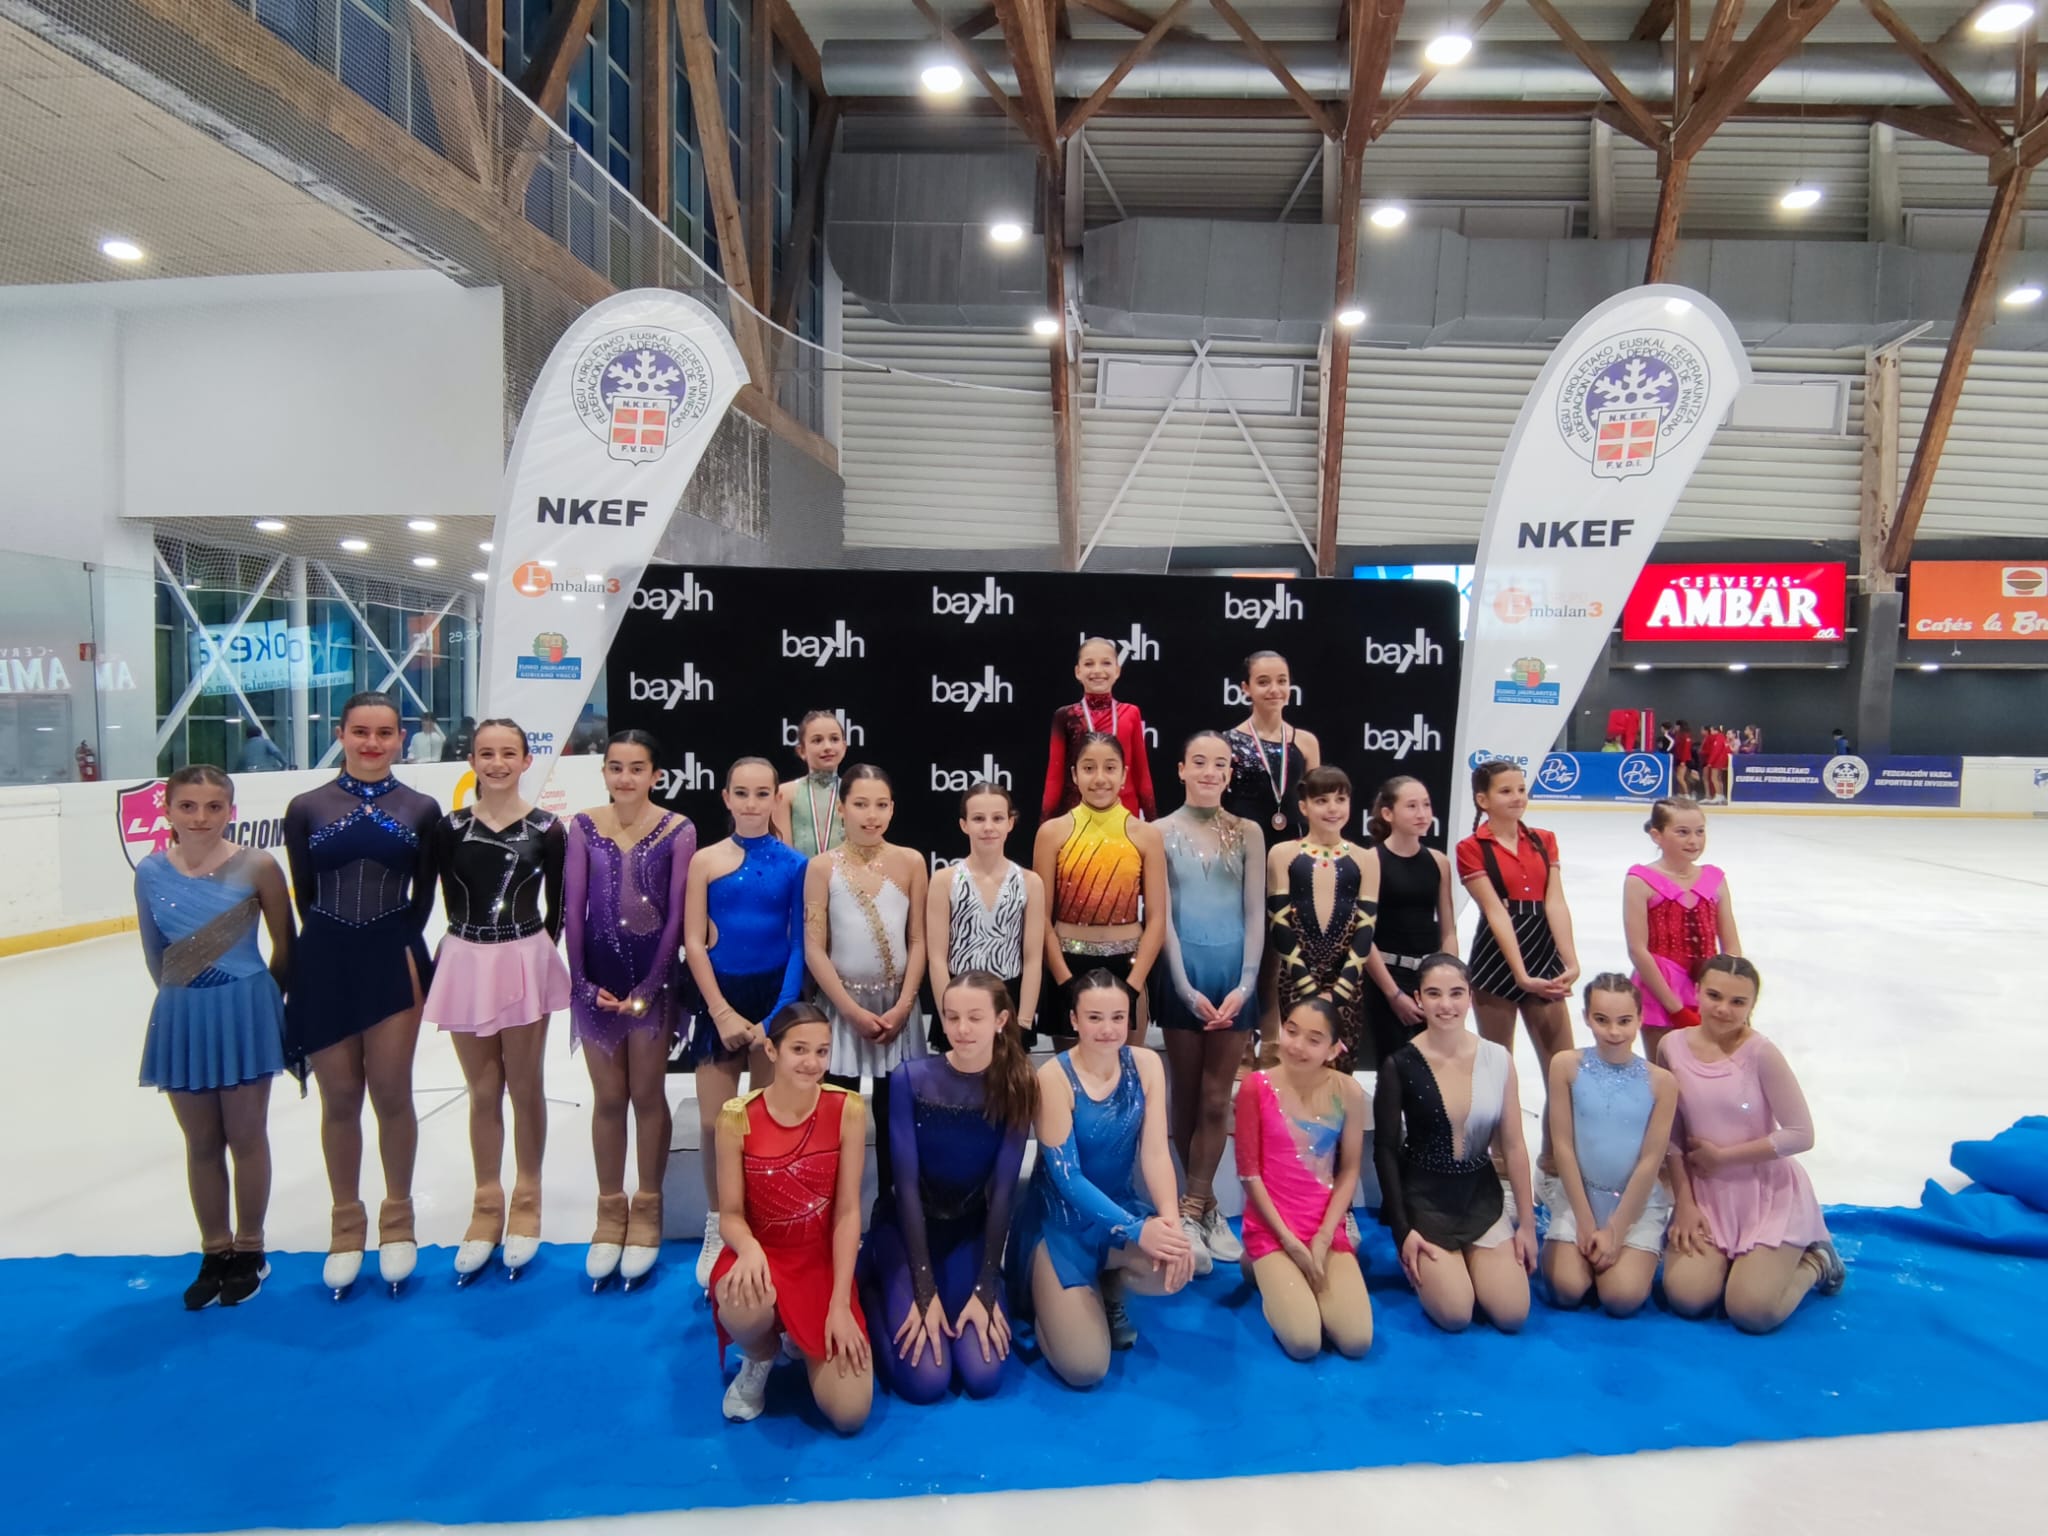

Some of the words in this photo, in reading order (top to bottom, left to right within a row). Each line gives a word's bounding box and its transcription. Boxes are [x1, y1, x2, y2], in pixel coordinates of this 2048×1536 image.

[630, 332, 672, 345] EUSKAL
[1619, 337, 1665, 350] EUSKAL
[577, 335, 624, 383] KIROLETAKO
[602, 342, 634, 361] VASCA
[685, 368, 697, 382] DE
[1588, 353, 1624, 377] VASCA
[1679, 369, 1692, 385] DE
[677, 343, 708, 419] FEDERAKUNTZA
[1562, 346, 1613, 403] KIROLETAKO
[1672, 344, 1704, 424] FEDERAKUNTZA
[576, 388, 590, 417] NEGU
[1561, 408, 1575, 438] NEGU
[537, 496, 648, 527] NKEF
[1518, 519, 1635, 549] NKEF
[1678, 576, 1791, 588] CERVEZAS
[1646, 588, 1822, 627] AMBAR
[1916, 617, 1973, 633] Cafés
[1983, 612, 2003, 632] la
[527, 731, 553, 744] que
[530, 744, 553, 755] am
